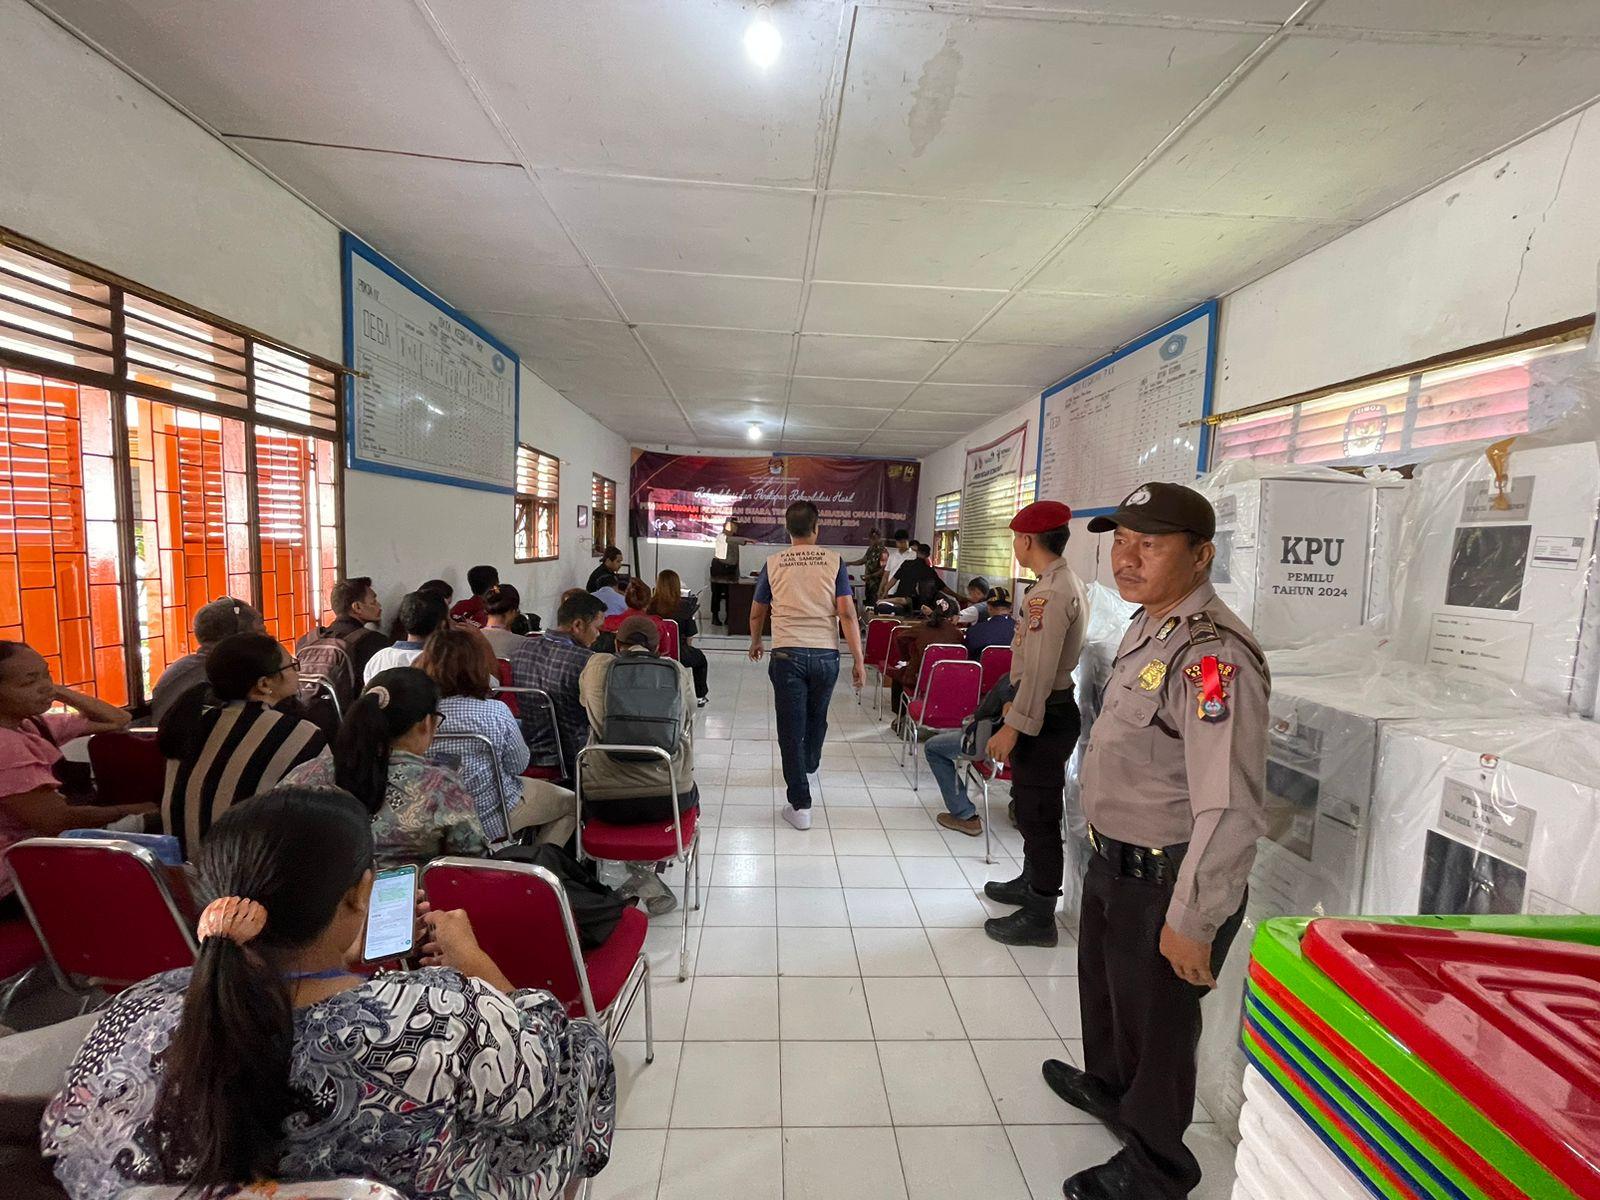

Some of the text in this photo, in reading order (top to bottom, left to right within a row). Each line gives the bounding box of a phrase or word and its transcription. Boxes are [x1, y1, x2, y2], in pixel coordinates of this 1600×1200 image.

[363, 309, 391, 349] DESA
[832, 491, 855, 503] Hasil
[1280, 536, 1345, 567] KPU
[1287, 572, 1334, 583] PEMILU
[1272, 585, 1348, 598] TAHUN 2024
